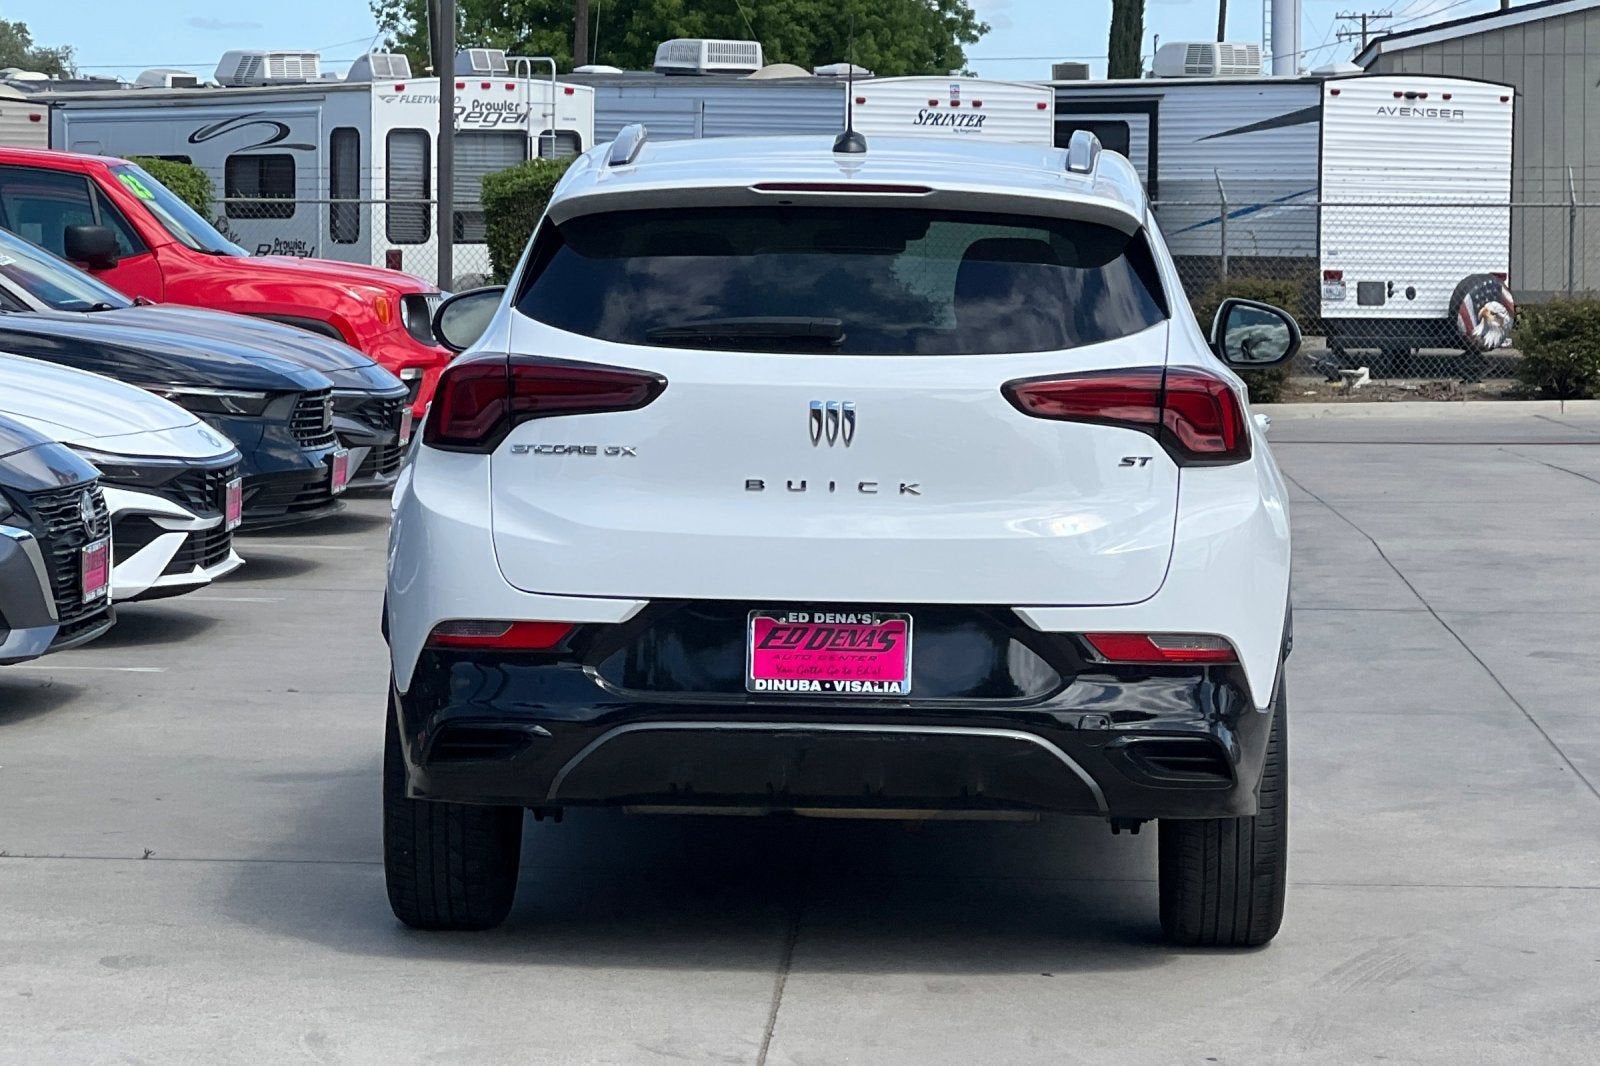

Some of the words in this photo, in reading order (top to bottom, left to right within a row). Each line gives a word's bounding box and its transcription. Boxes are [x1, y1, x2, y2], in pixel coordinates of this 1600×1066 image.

[400, 94, 461, 105] FLEETWD
[471, 99, 520, 112] Prowler
[913, 108, 986, 128] SPRINTER
[1376, 105, 1464, 118] AVENGER
[274, 237, 306, 250] Prowler
[511, 444, 598, 456] ENCORE
[604, 446, 637, 457] GX
[1118, 456, 1153, 468] ST
[744, 479, 921, 496] BUICK
[788, 612, 809, 624] ED
[813, 613, 872, 625] DENA'S
[757, 626, 808, 650] ED
[801, 627, 903, 653] DENA'S
[755, 679, 821, 691] DINUBA
[833, 681, 901, 693] VISALIA
